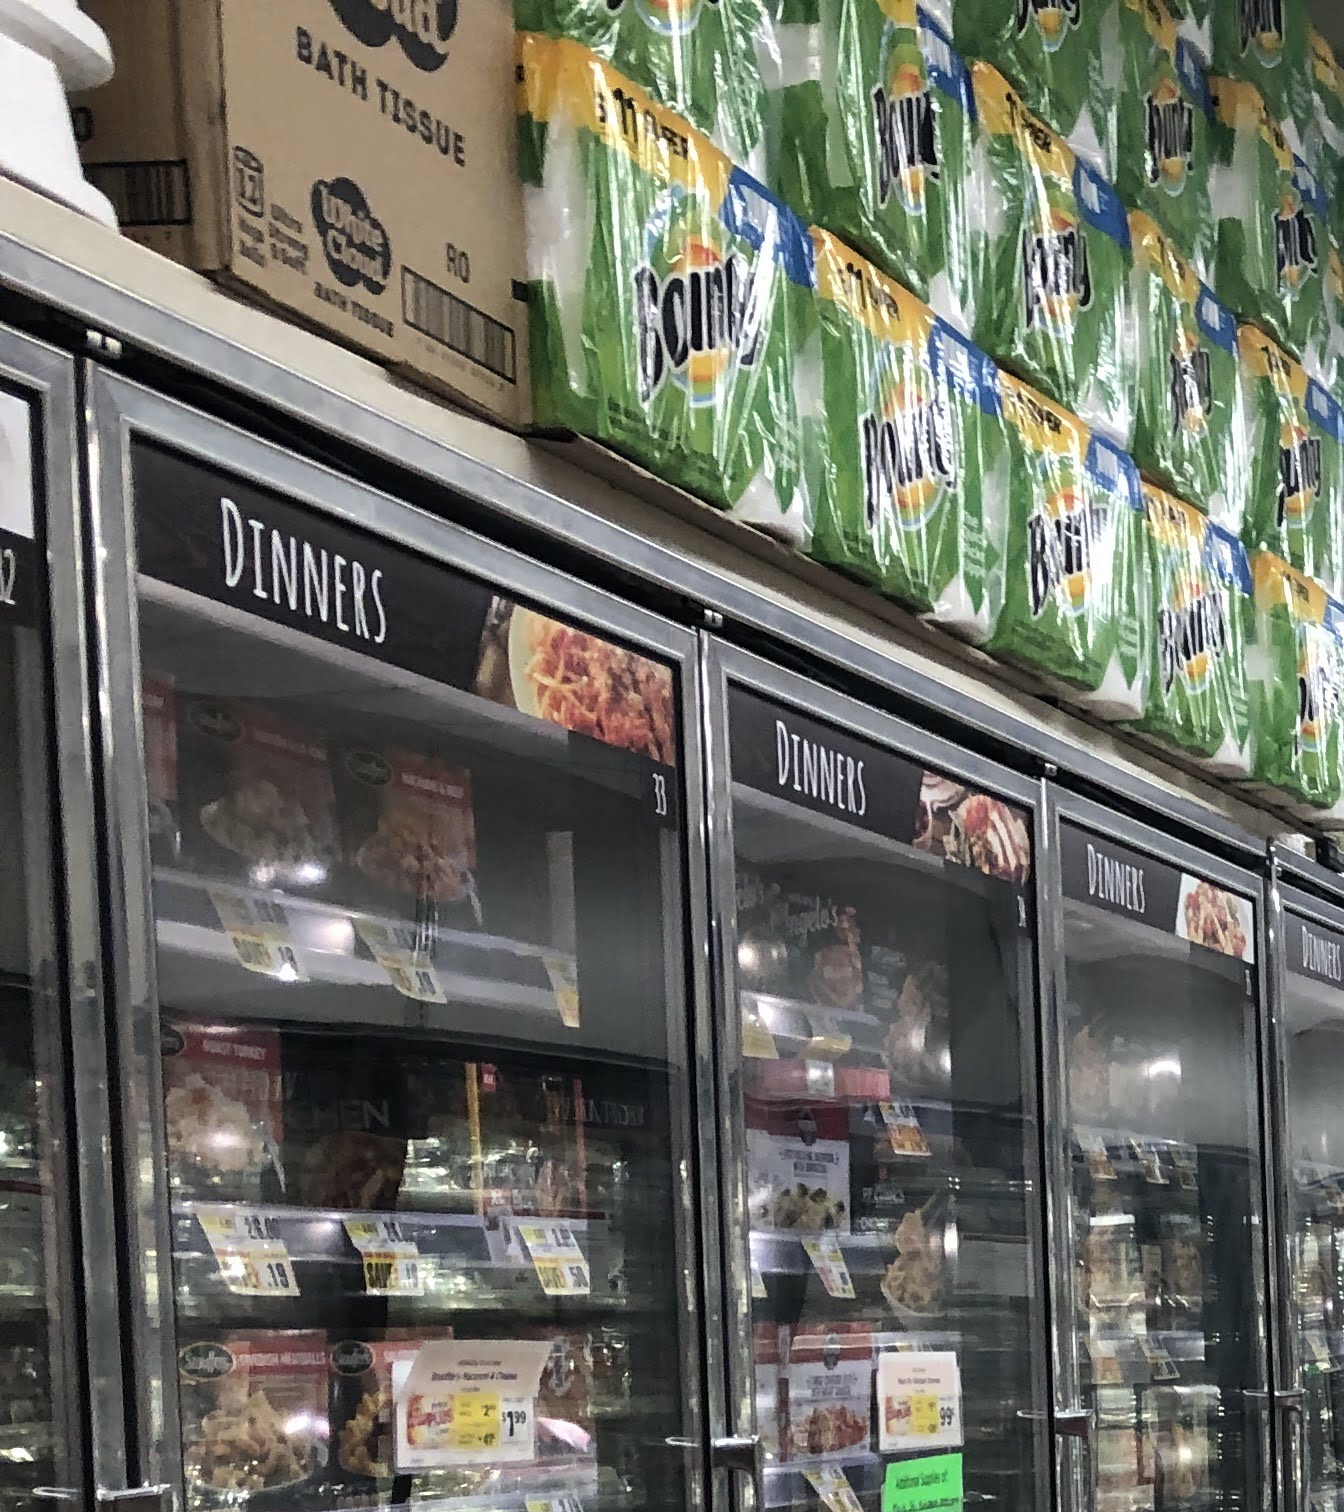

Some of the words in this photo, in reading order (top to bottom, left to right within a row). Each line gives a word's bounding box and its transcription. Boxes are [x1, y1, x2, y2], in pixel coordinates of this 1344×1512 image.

[296, 25, 369, 101] BATH
[376, 78, 466, 168] TISSUE
[220, 497, 386, 644] DINNERS
[776, 719, 866, 816] DINNERS
[1087, 843, 1145, 914] DINNERS
